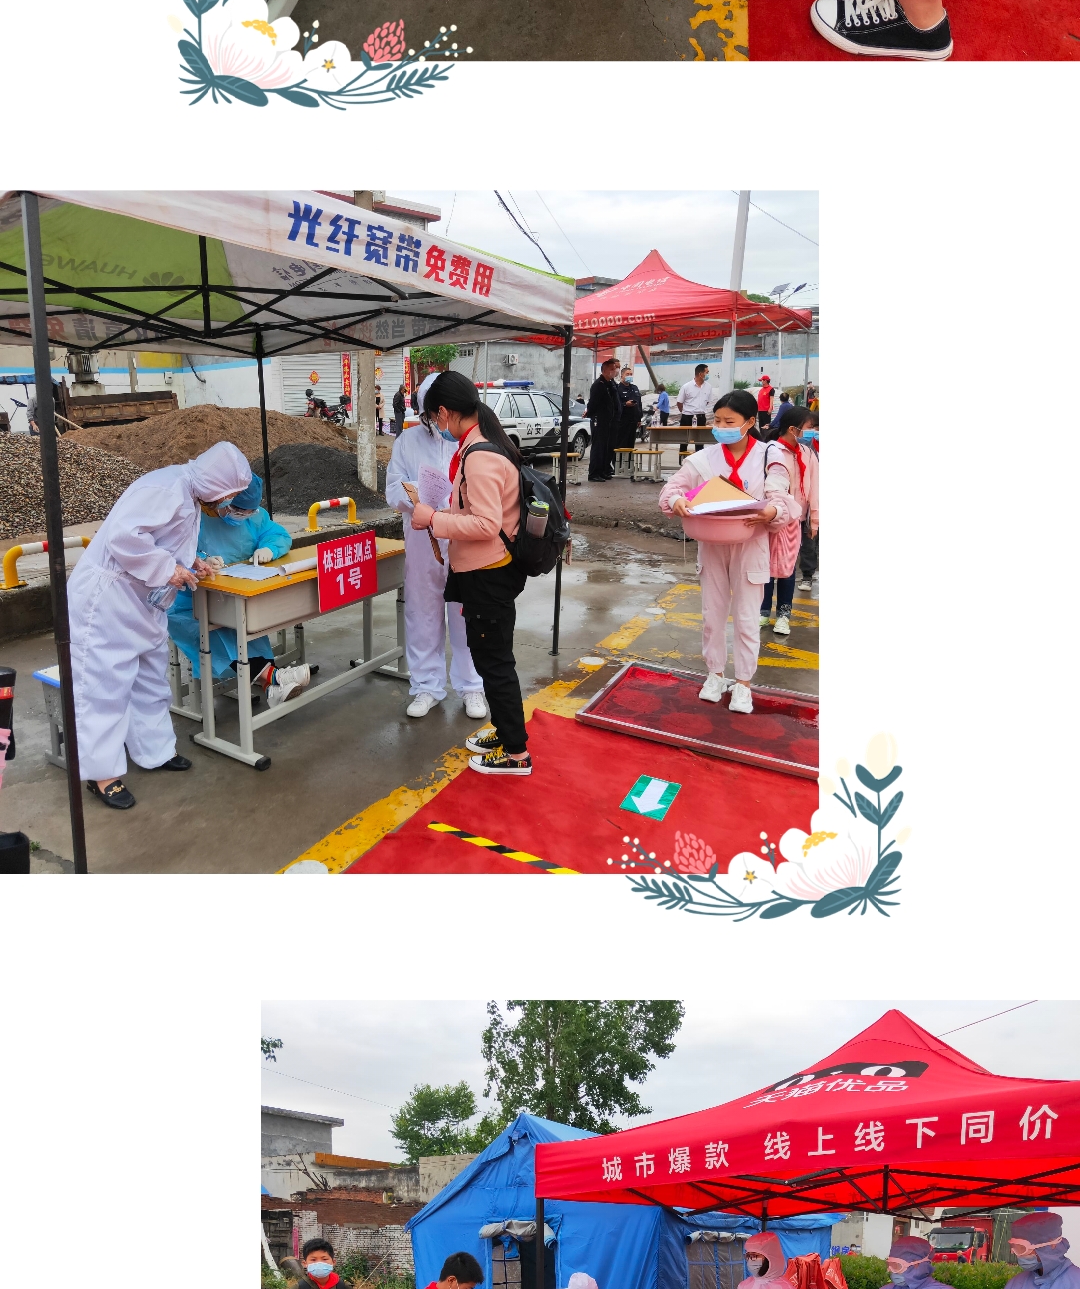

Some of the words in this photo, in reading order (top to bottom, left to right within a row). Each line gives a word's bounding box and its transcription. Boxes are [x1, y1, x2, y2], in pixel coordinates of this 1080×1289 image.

[526, 423, 544, 436] 公安
[322, 539, 373, 573] 体温监测点
[336, 567, 363, 595] 1号
[743, 1078, 908, 1109] 天猫优品
[602, 1141, 729, 1182] 城市爆款
[764, 1104, 1059, 1161] 线上线下同价
